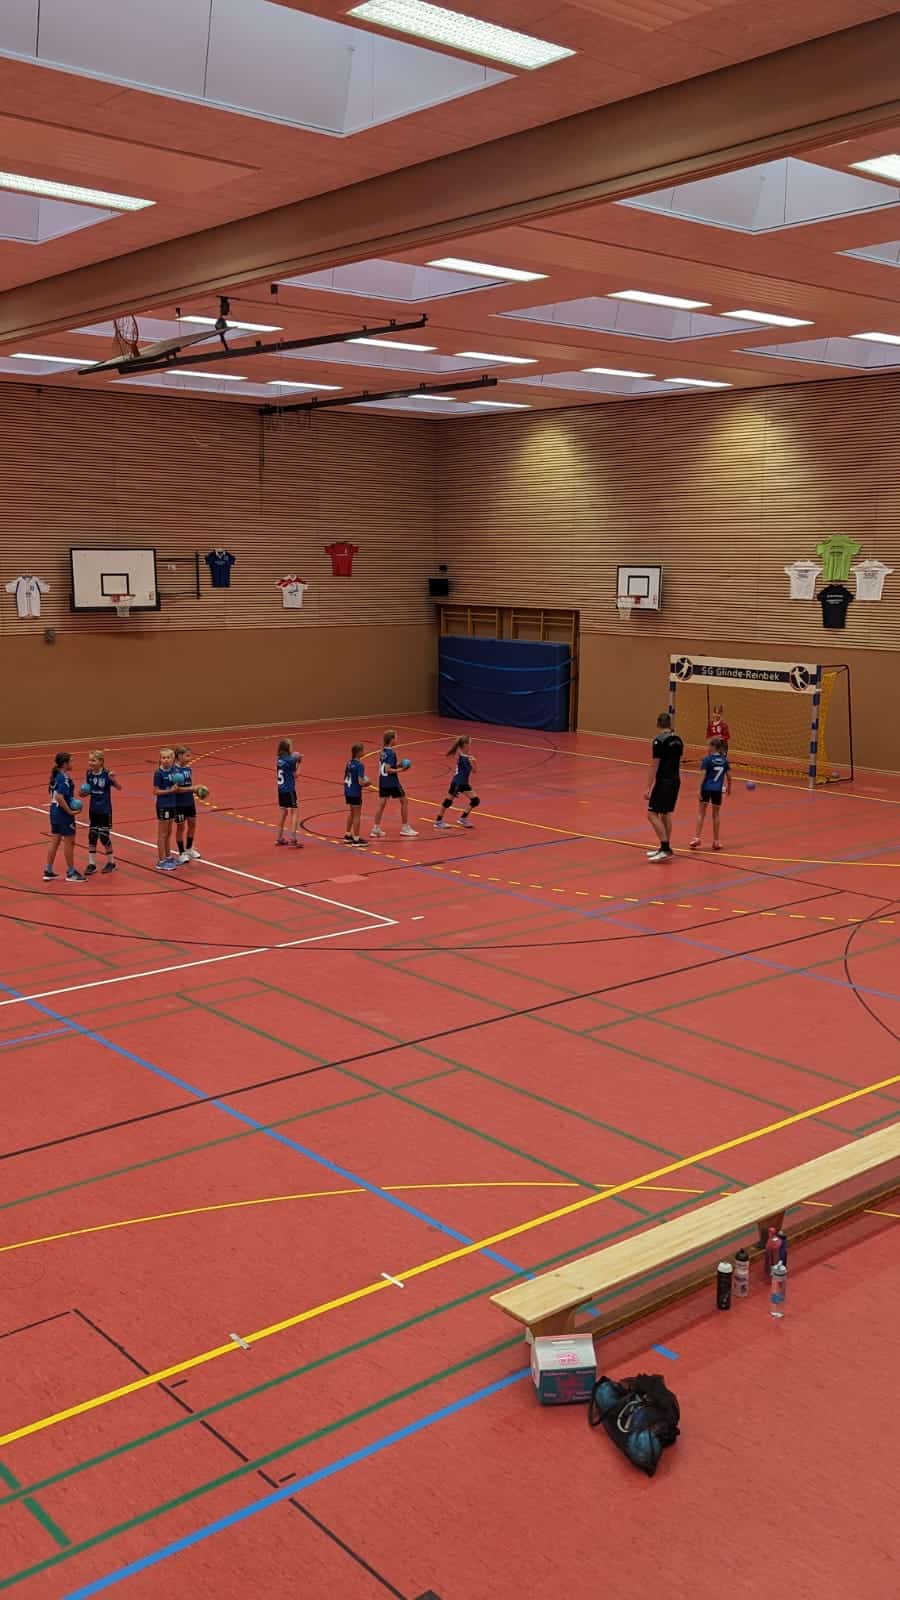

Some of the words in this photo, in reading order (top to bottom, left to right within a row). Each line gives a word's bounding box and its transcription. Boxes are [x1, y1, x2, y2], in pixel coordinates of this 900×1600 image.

[702, 666, 714, 675] SG
[716, 667, 780, 681] Glinde-Reinbek
[277, 769, 285, 785] 5
[344, 773, 352, 787] 4
[713, 766, 724, 782] 7
